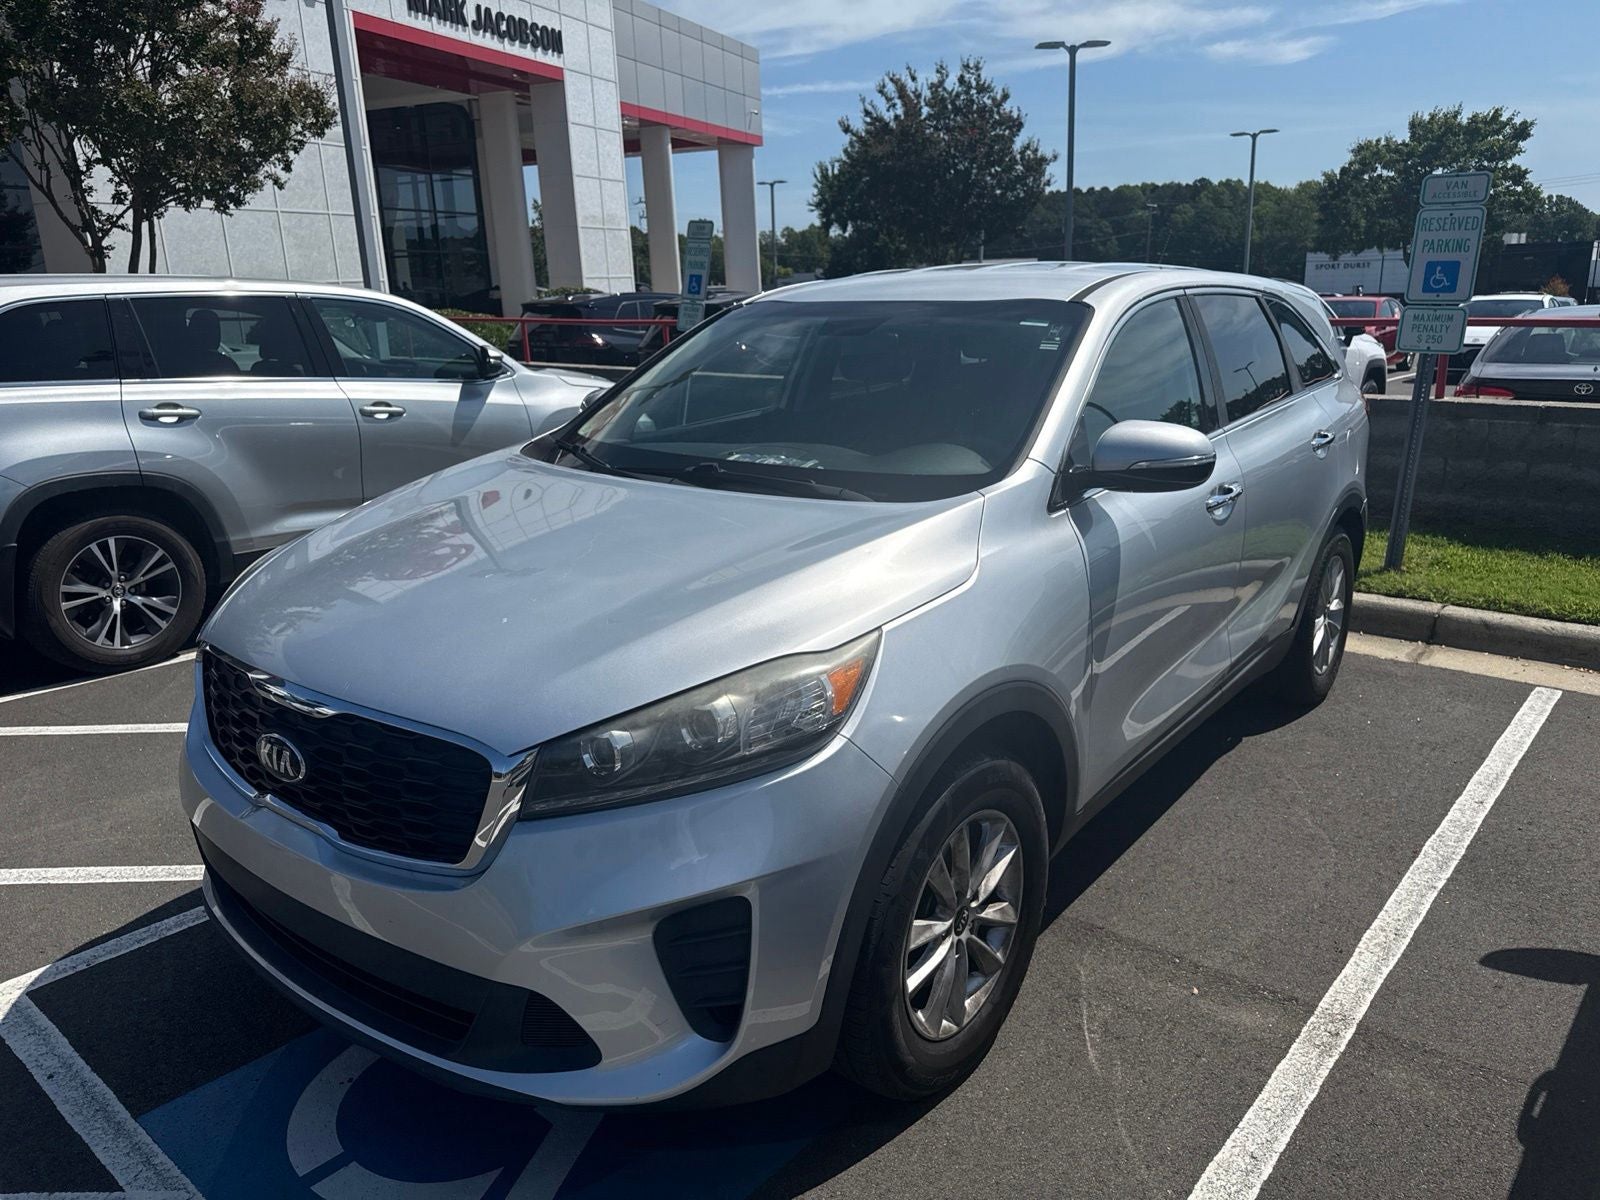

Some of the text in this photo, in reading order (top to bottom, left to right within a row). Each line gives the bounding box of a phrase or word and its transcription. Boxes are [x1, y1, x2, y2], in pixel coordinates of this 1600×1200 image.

[471, 4, 563, 54] JACOBSON
[1445, 180, 1469, 190] VAN
[1431, 190, 1479, 200] ACCESSIBLE
[1420, 215, 1480, 232] RESERVED
[1421, 238, 1471, 254] PARKING
[1412, 313, 1454, 323] MAXIMUM
[1411, 323, 1451, 334] PENALTY
[1425, 335, 1443, 344] 250
[261, 739, 295, 777] KIA
